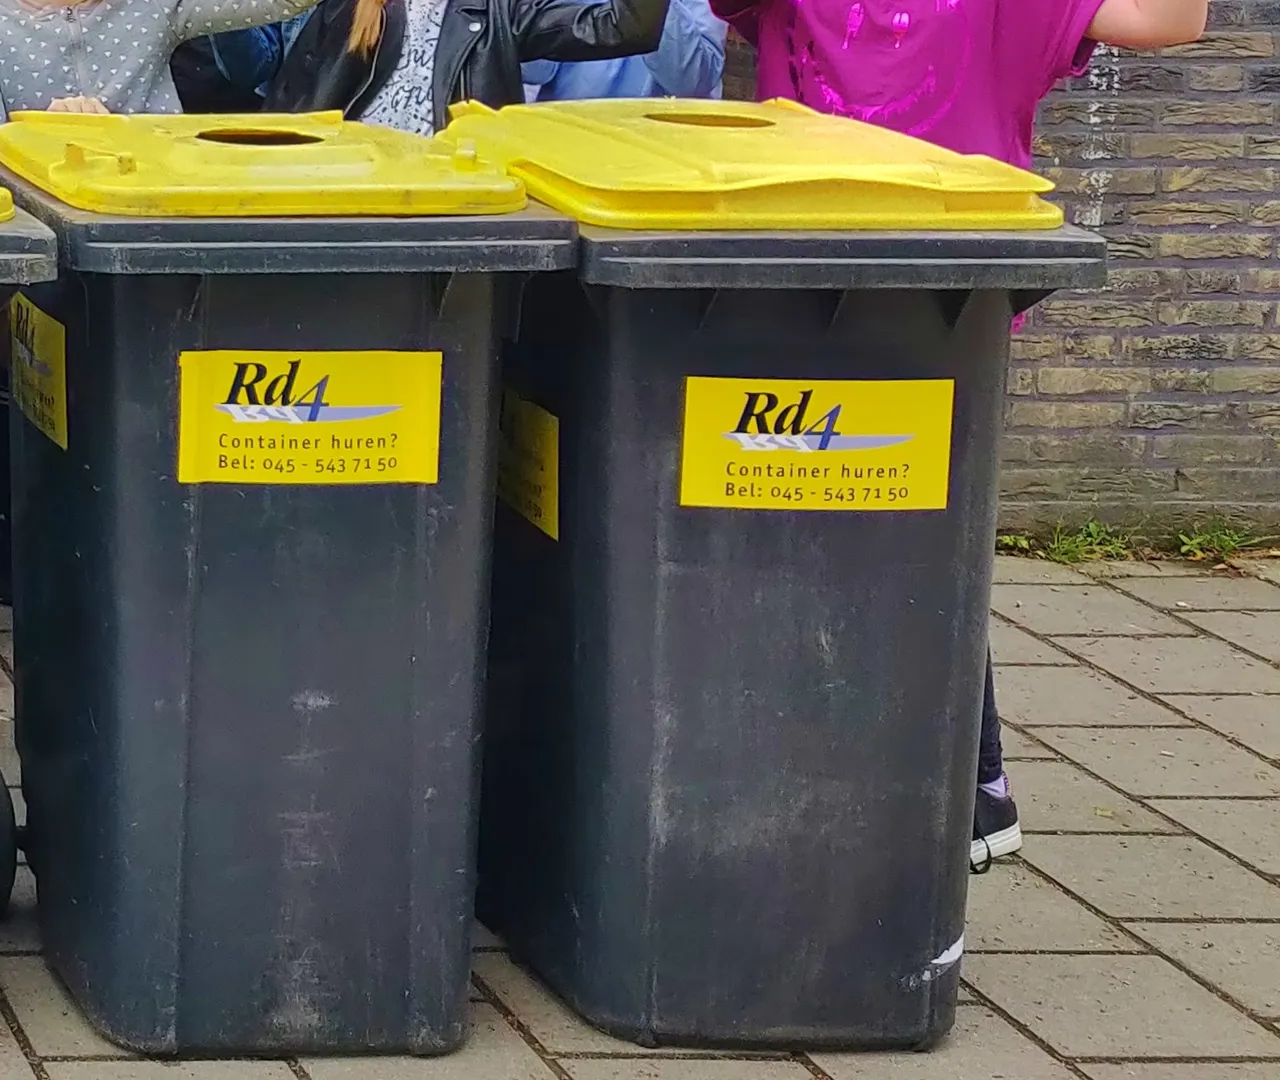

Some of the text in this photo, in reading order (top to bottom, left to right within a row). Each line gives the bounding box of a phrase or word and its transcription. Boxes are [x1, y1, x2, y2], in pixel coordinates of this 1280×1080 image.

[221, 358, 330, 422] Rd4
[730, 389, 842, 451] Rd4
[218, 432, 398, 450] Container huren?
[218, 453, 255, 470] Bel:
[726, 461, 910, 479] Container huren?
[725, 481, 763, 498] Bel:
